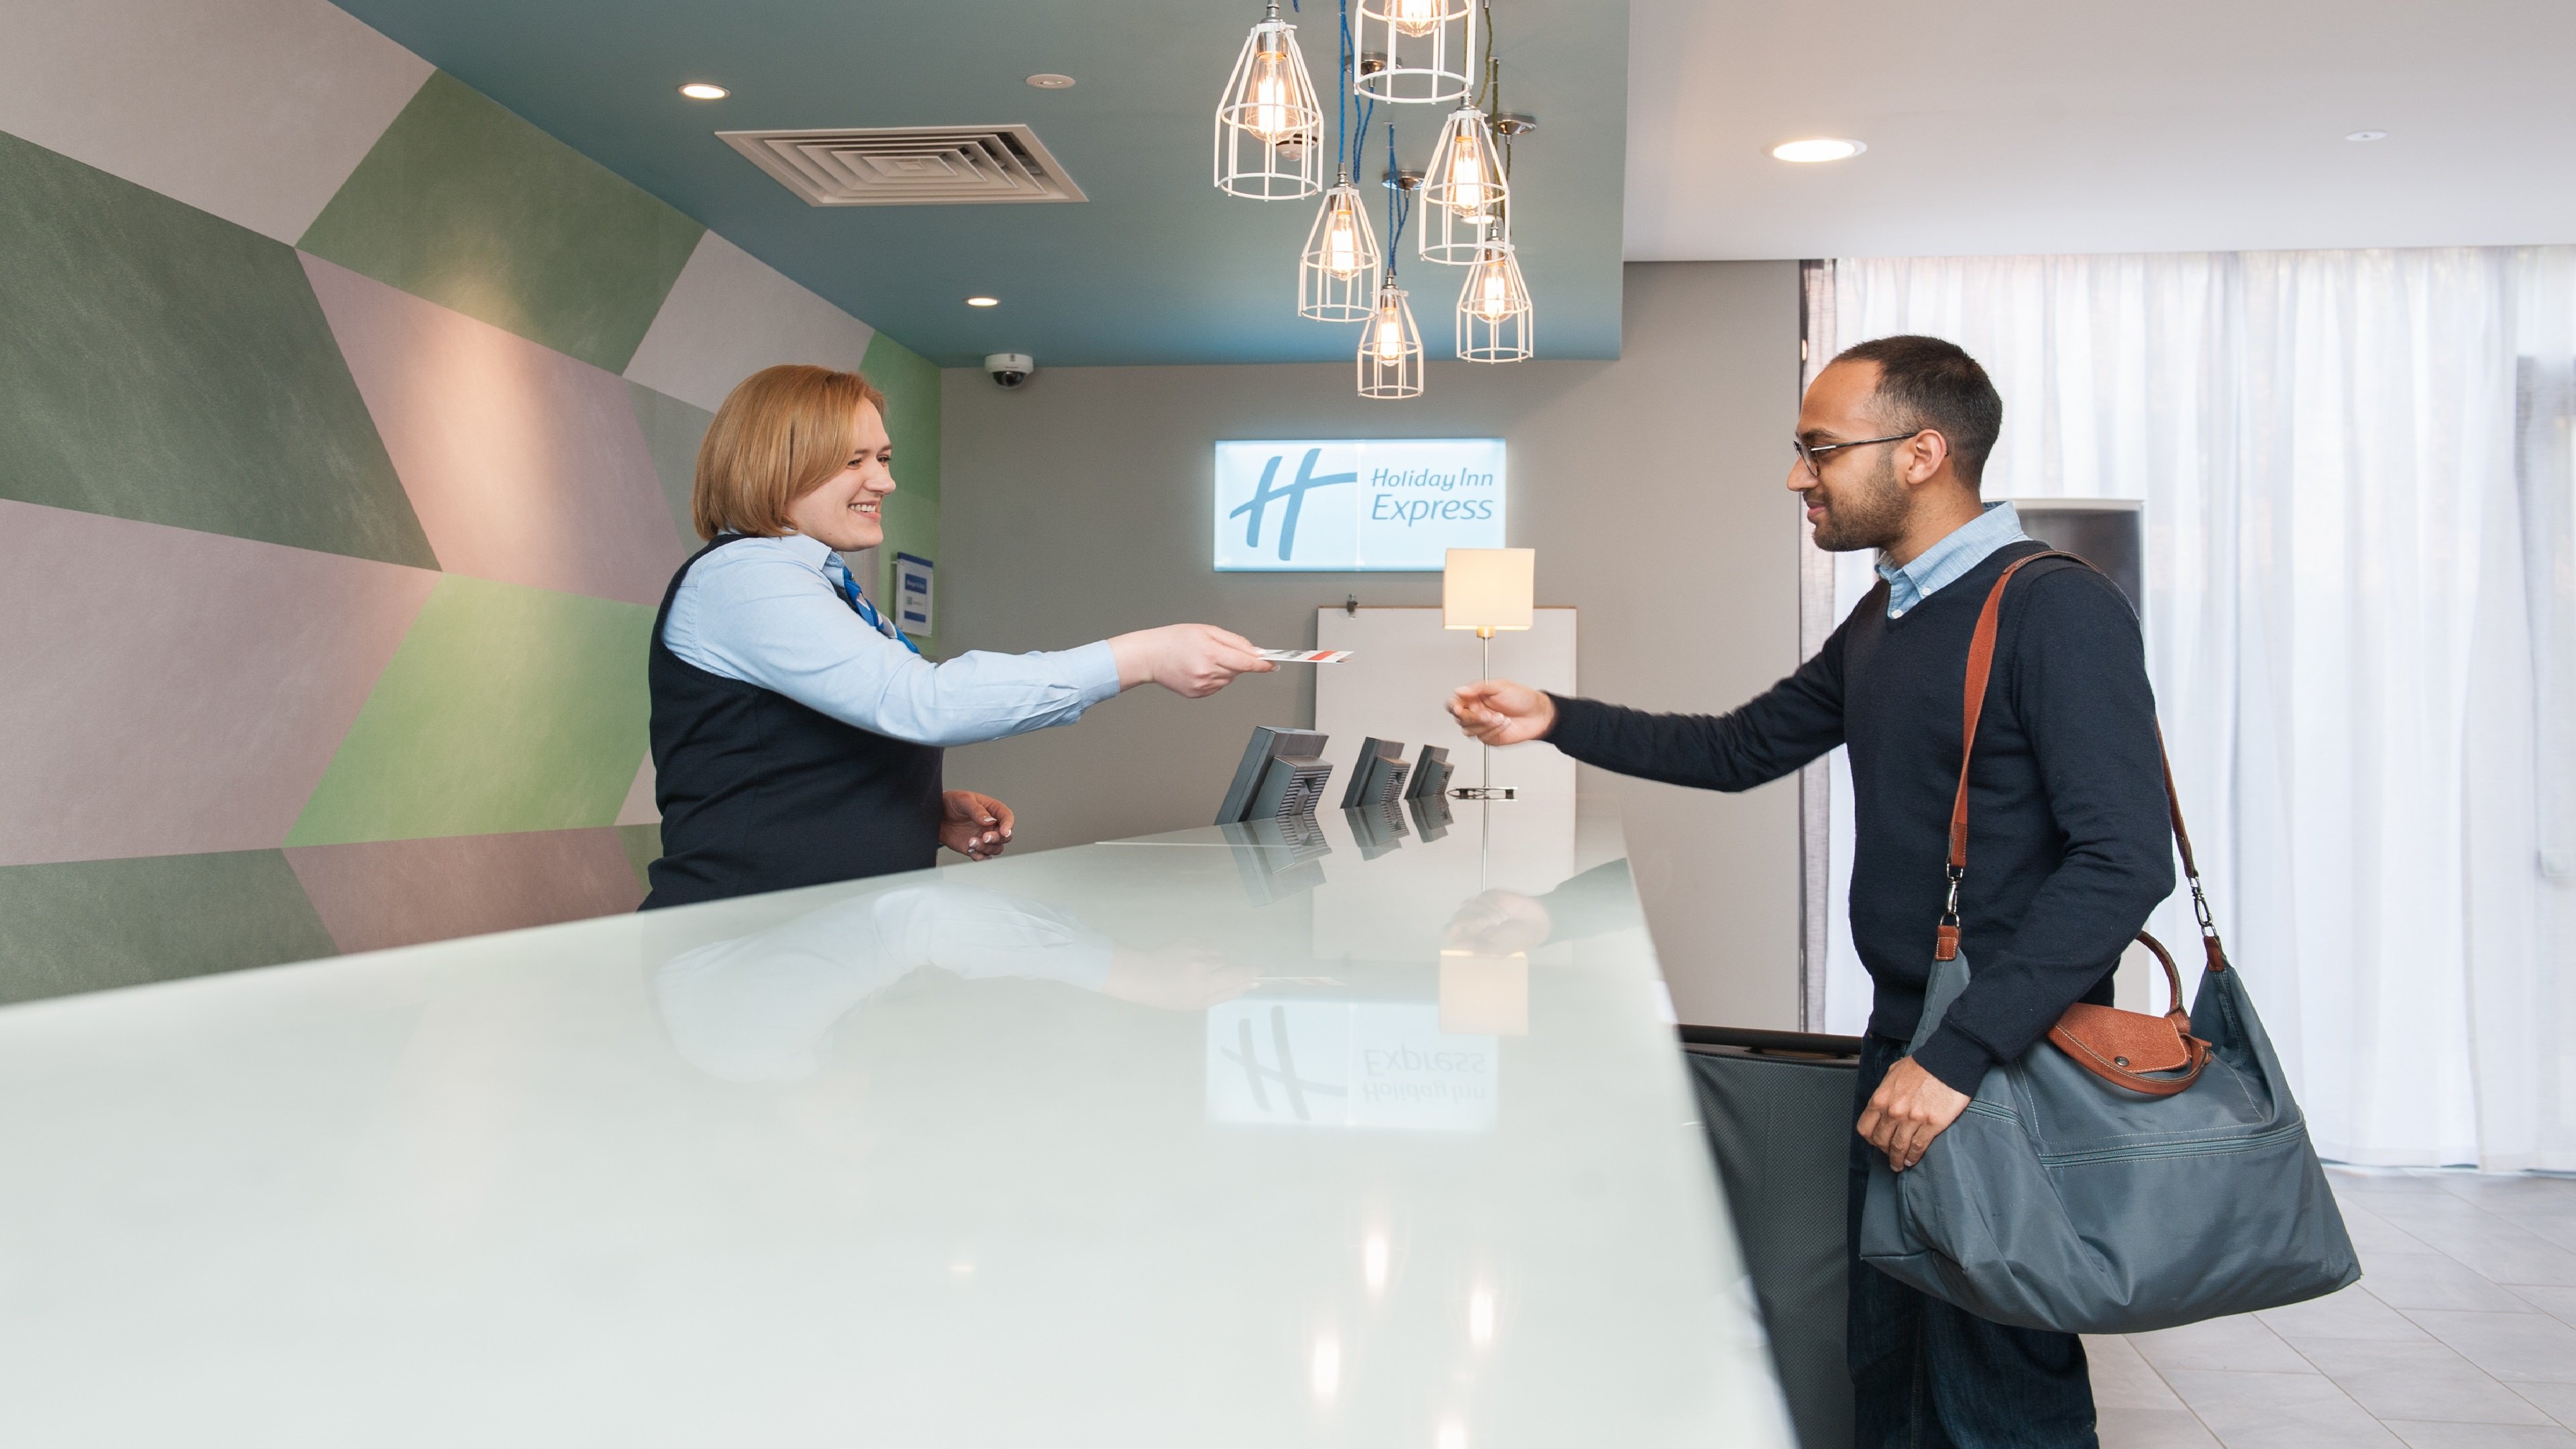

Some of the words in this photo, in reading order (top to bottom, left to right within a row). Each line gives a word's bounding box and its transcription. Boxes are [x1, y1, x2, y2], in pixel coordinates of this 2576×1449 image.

[1371, 468, 1455, 491] Holiday
[1460, 468, 1493, 486] Inn
[1371, 494, 1493, 527] Express
